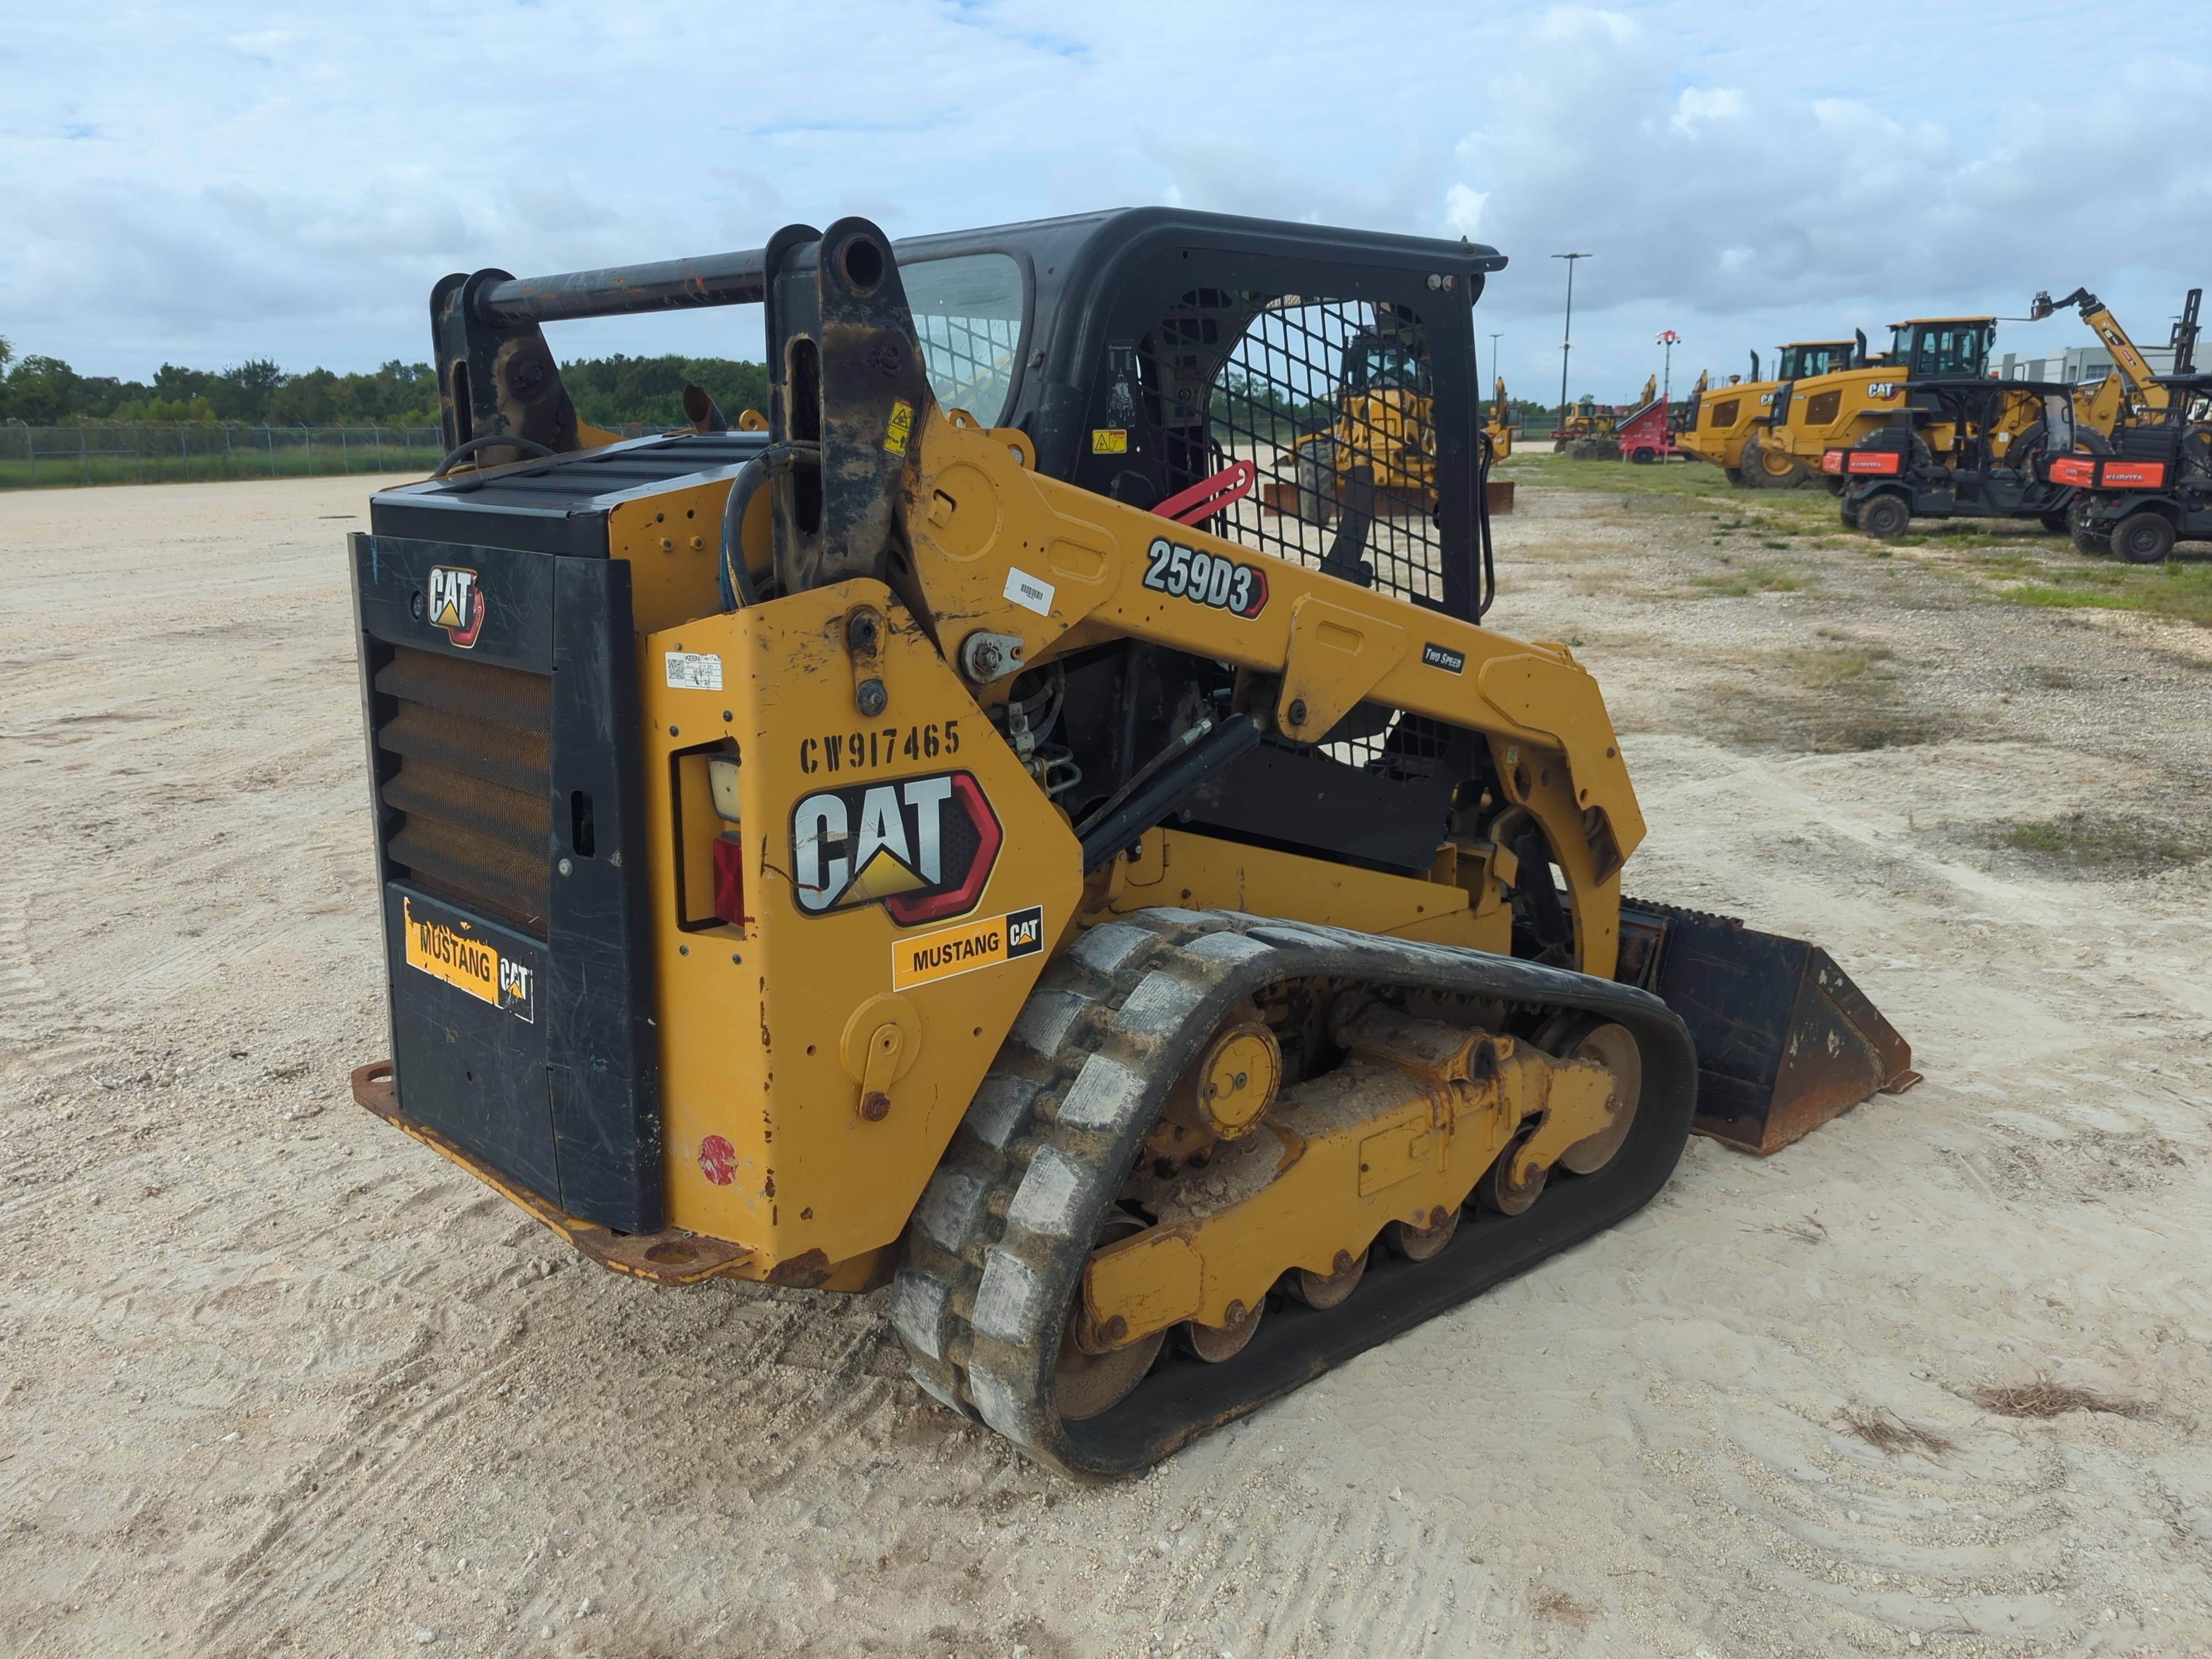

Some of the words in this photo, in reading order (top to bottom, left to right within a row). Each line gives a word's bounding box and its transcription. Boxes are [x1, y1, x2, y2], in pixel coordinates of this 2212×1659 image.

[1760, 394, 1774, 405] CA
[1868, 383, 1893, 398] CAT
[429, 568, 471, 627] CAT
[1144, 540, 1252, 612] 259D3
[800, 720, 960, 774] CW917465
[795, 776, 951, 910] CAT
[420, 924, 490, 983] MUSTANG
[500, 957, 528, 1000] CAT
[913, 932, 1000, 973] MUSTANG
[1009, 918, 1039, 946] CAT
